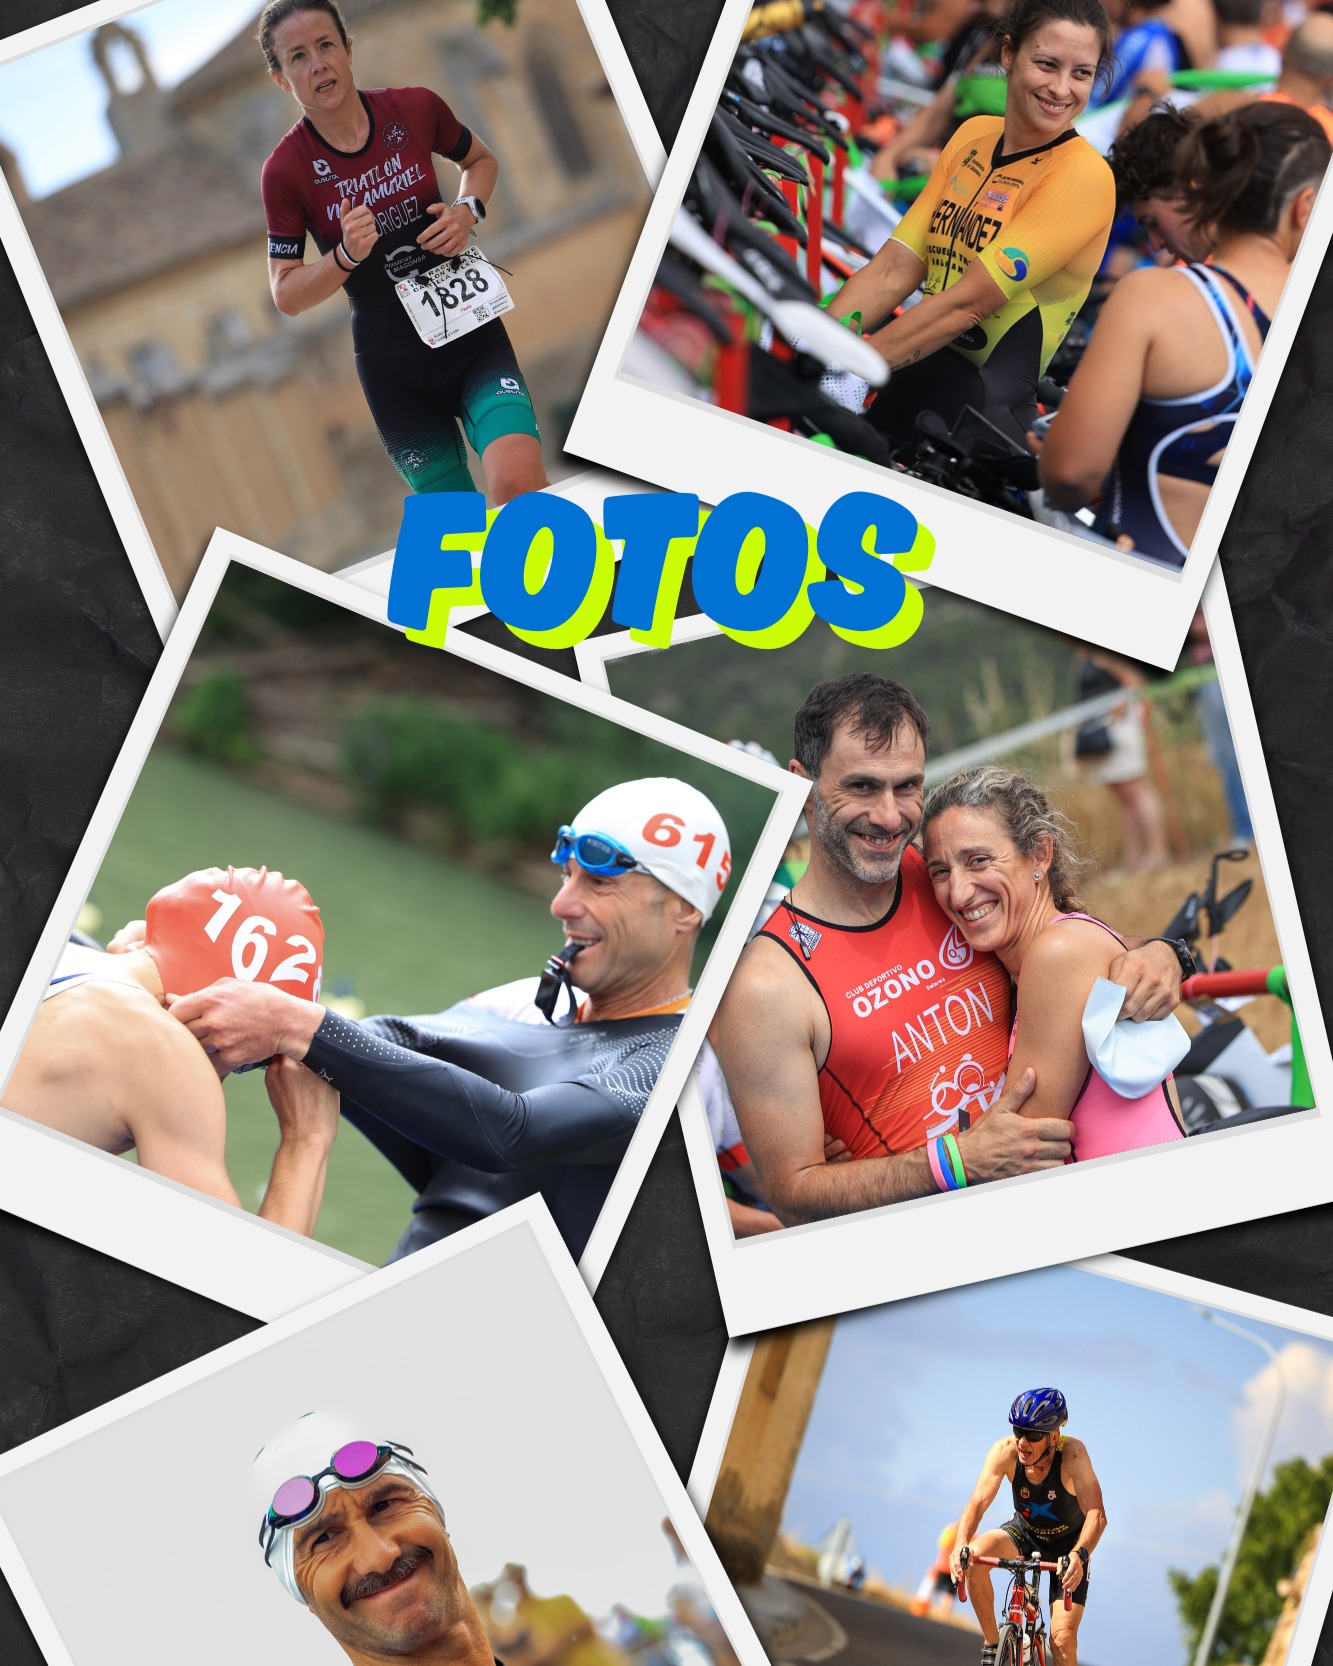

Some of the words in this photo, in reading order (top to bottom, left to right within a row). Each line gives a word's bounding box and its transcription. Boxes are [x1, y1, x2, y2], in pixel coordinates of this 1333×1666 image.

[326, 163, 427, 221] VILAMURIEL
[420, 268, 489, 317] 1828
[641, 813, 732, 892] 615
[845, 984, 865, 999] CLUB
[865, 964, 903, 989] DEPORTIVO
[852, 959, 936, 1018] OZONO
[889, 981, 995, 1074] ANTON
